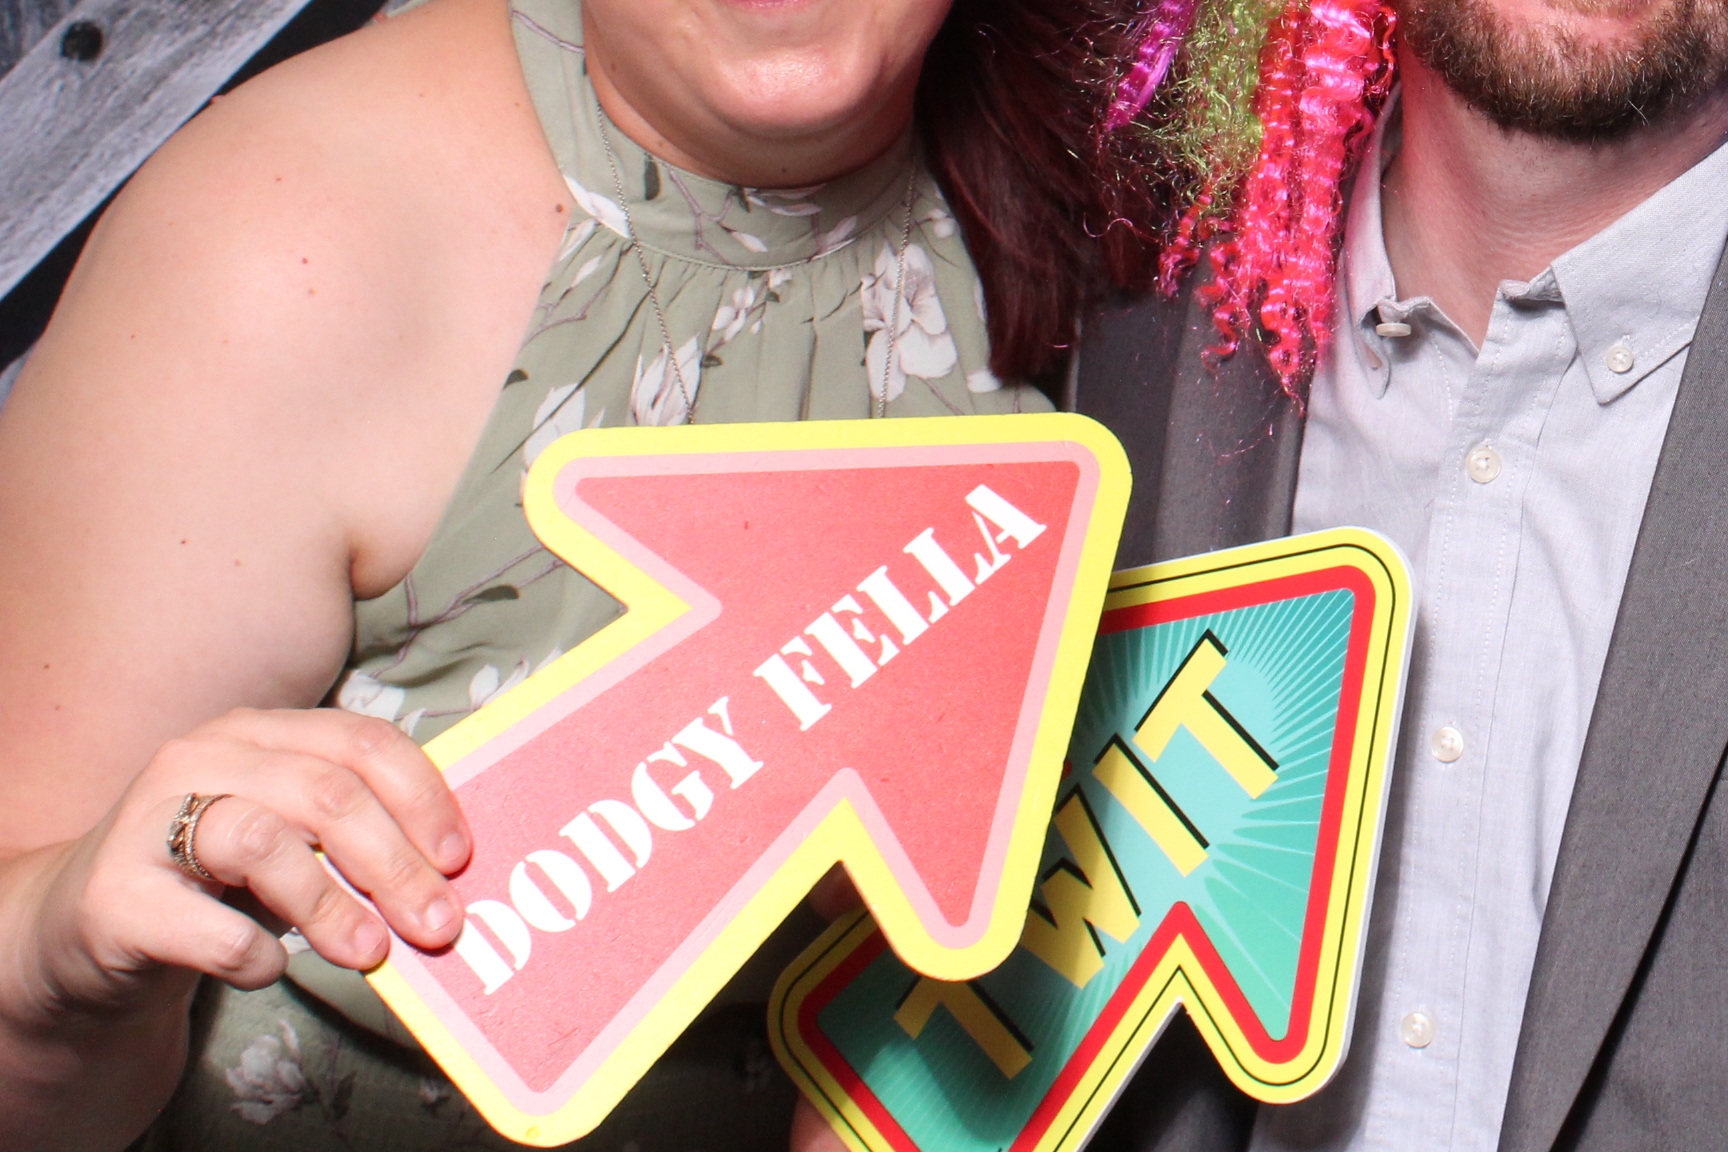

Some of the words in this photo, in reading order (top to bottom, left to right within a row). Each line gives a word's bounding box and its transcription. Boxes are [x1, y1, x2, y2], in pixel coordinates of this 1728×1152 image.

[455, 696, 763, 996] DODGY
[753, 483, 1047, 732] FELLA
[893, 628, 1279, 1081] TWIT
